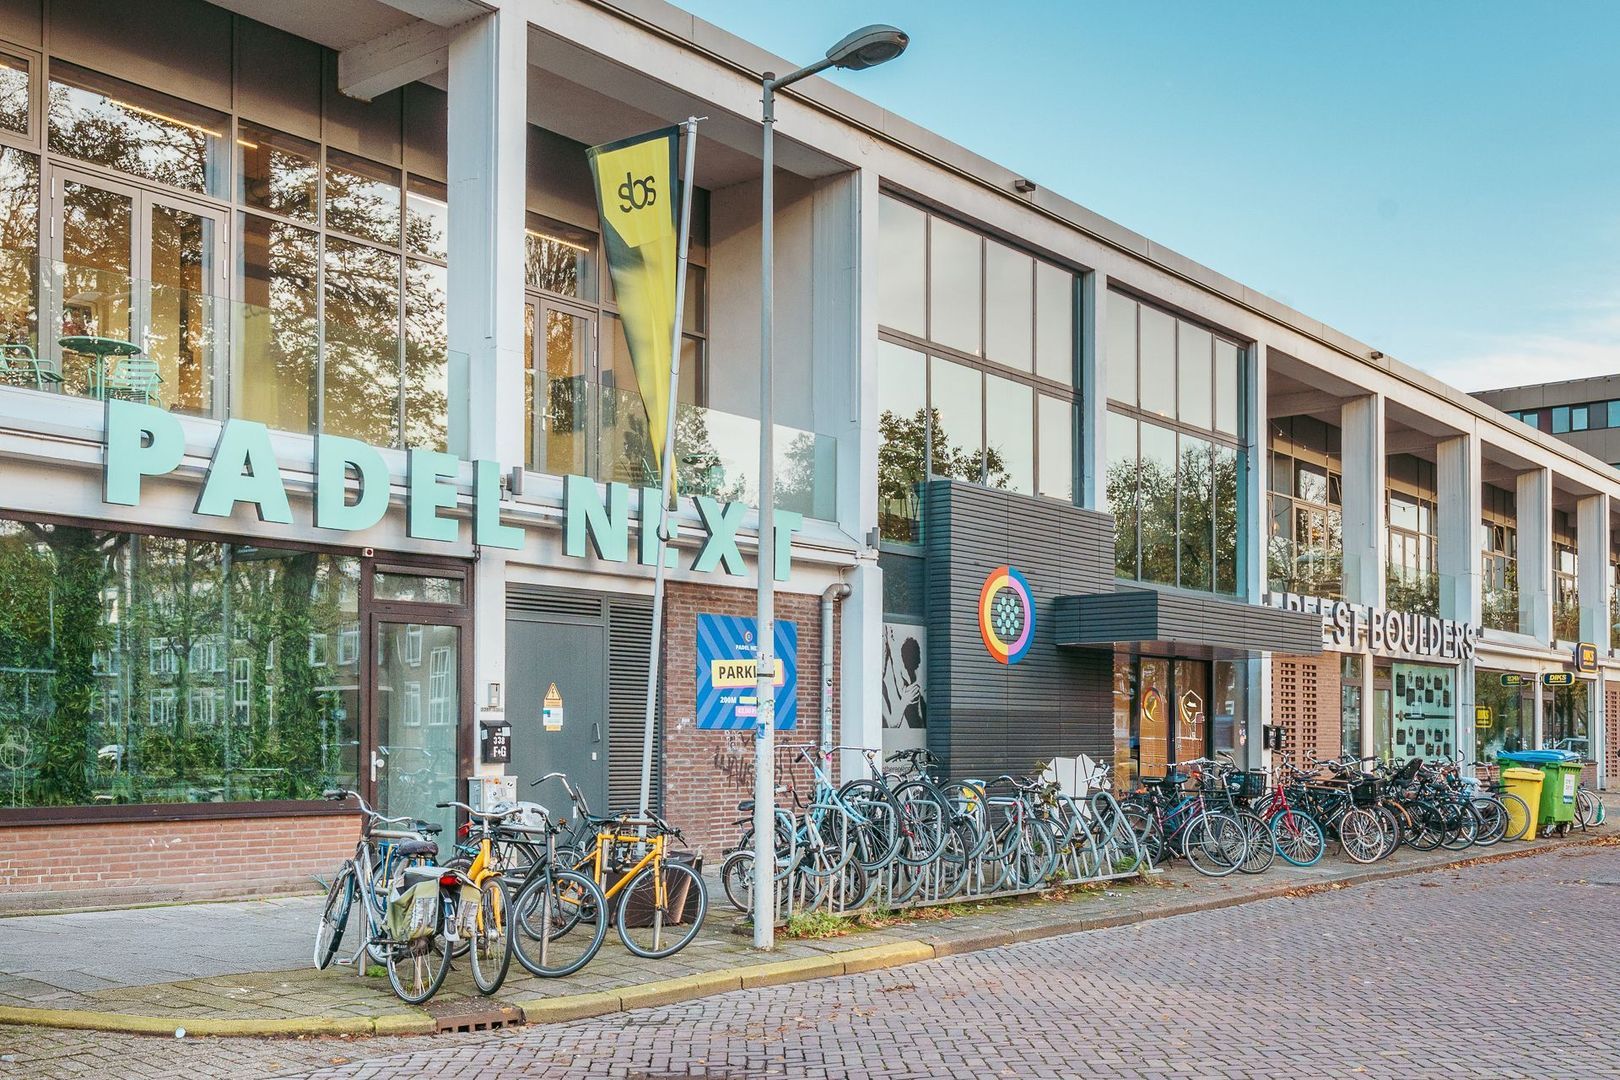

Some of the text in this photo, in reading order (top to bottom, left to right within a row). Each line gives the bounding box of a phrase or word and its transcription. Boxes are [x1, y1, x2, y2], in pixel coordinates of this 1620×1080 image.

[103, 399, 803, 582] PADEL NEXT
[1368, 607, 1476, 660] BOULDERS
[719, 665, 757, 679] PARKI
[493, 736, 506, 745] 338
